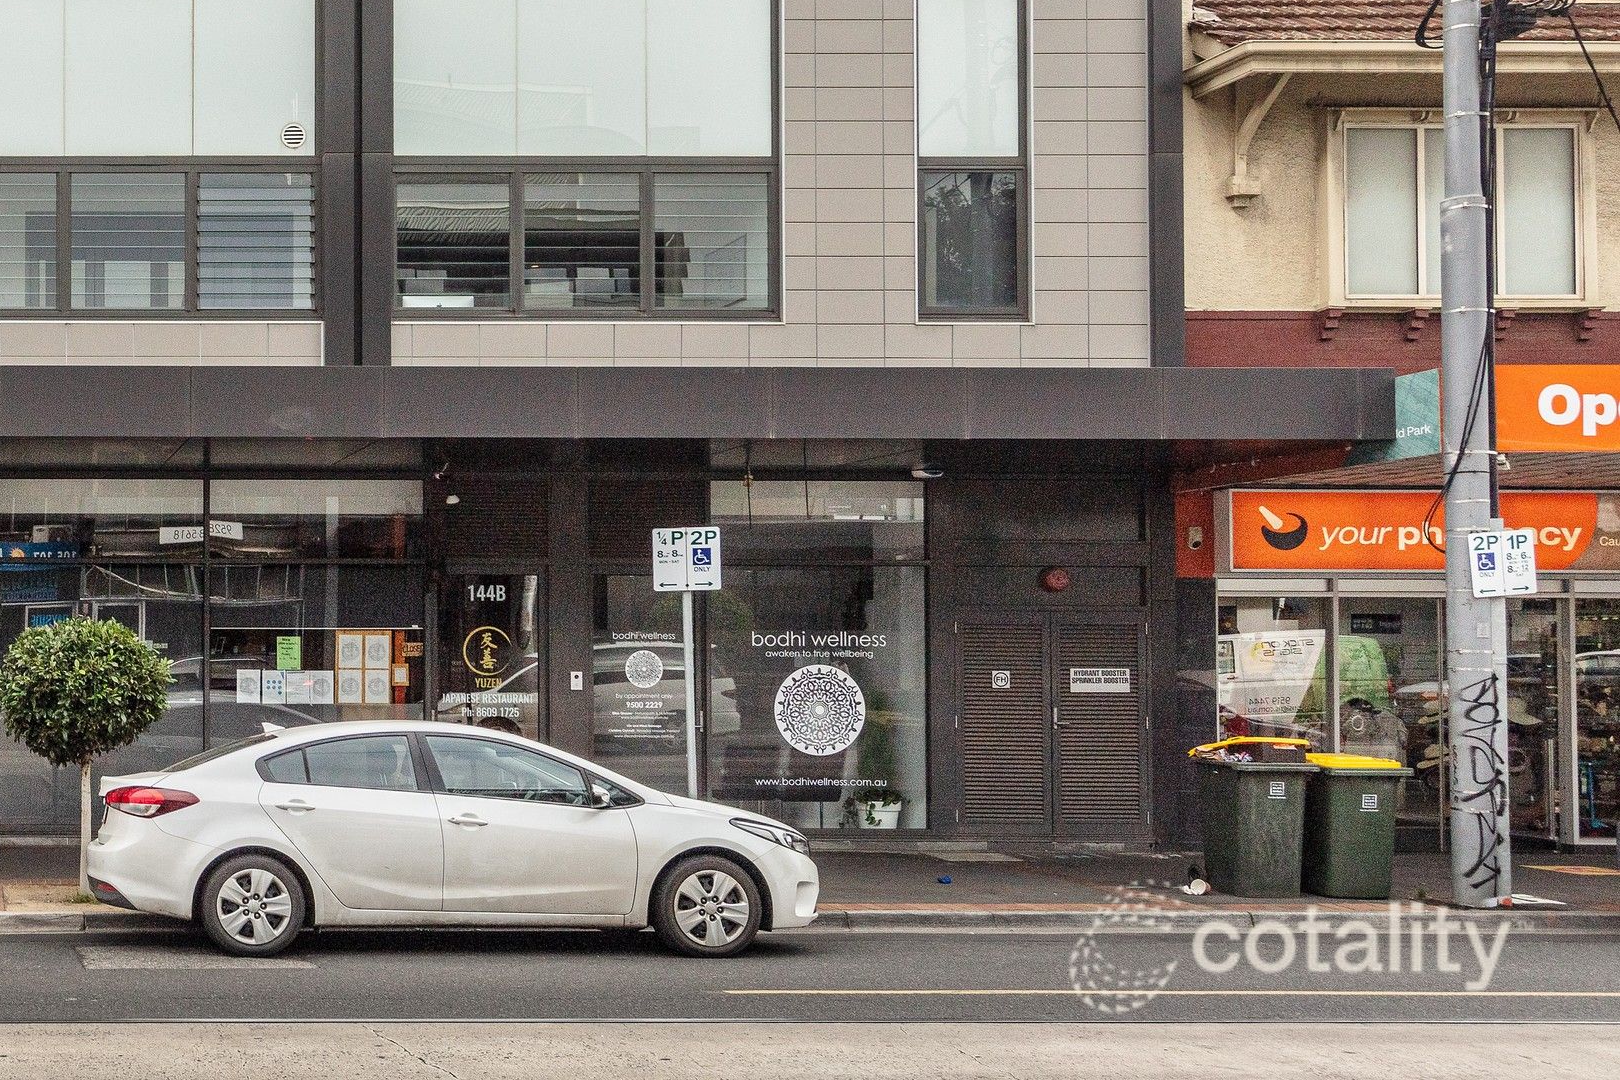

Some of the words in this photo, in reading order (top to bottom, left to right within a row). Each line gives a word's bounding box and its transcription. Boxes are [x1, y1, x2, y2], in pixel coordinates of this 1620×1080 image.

[1537, 383, 1620, 437] Op
[1407, 424, 1432, 437] Park
[672, 531, 684, 545] P
[691, 531, 717, 545] 2P
[1318, 526, 1390, 552] your
[1398, 523, 1583, 552] phcy
[1473, 535, 1499, 551] 2P
[1507, 534, 1528, 550] 1P
[467, 584, 507, 602] 144B
[640, 631, 676, 640] wellness
[751, 631, 806, 648] bodhi
[810, 631, 887, 648] wellness
[765, 650, 800, 658] awaken
[802, 650, 812, 658] to
[813, 650, 830, 658] true
[832, 649, 874, 659] wellbeing
[475, 678, 502, 688] YUZEN
[442, 694, 480, 704] JAPANESE
[482, 694, 534, 704] RESTAURANT
[461, 707, 474, 717] Ph:
[476, 707, 498, 717] 8609
[500, 707, 520, 717] 1725
[754, 777, 888, 787] www.bodhiwellness.com.au
